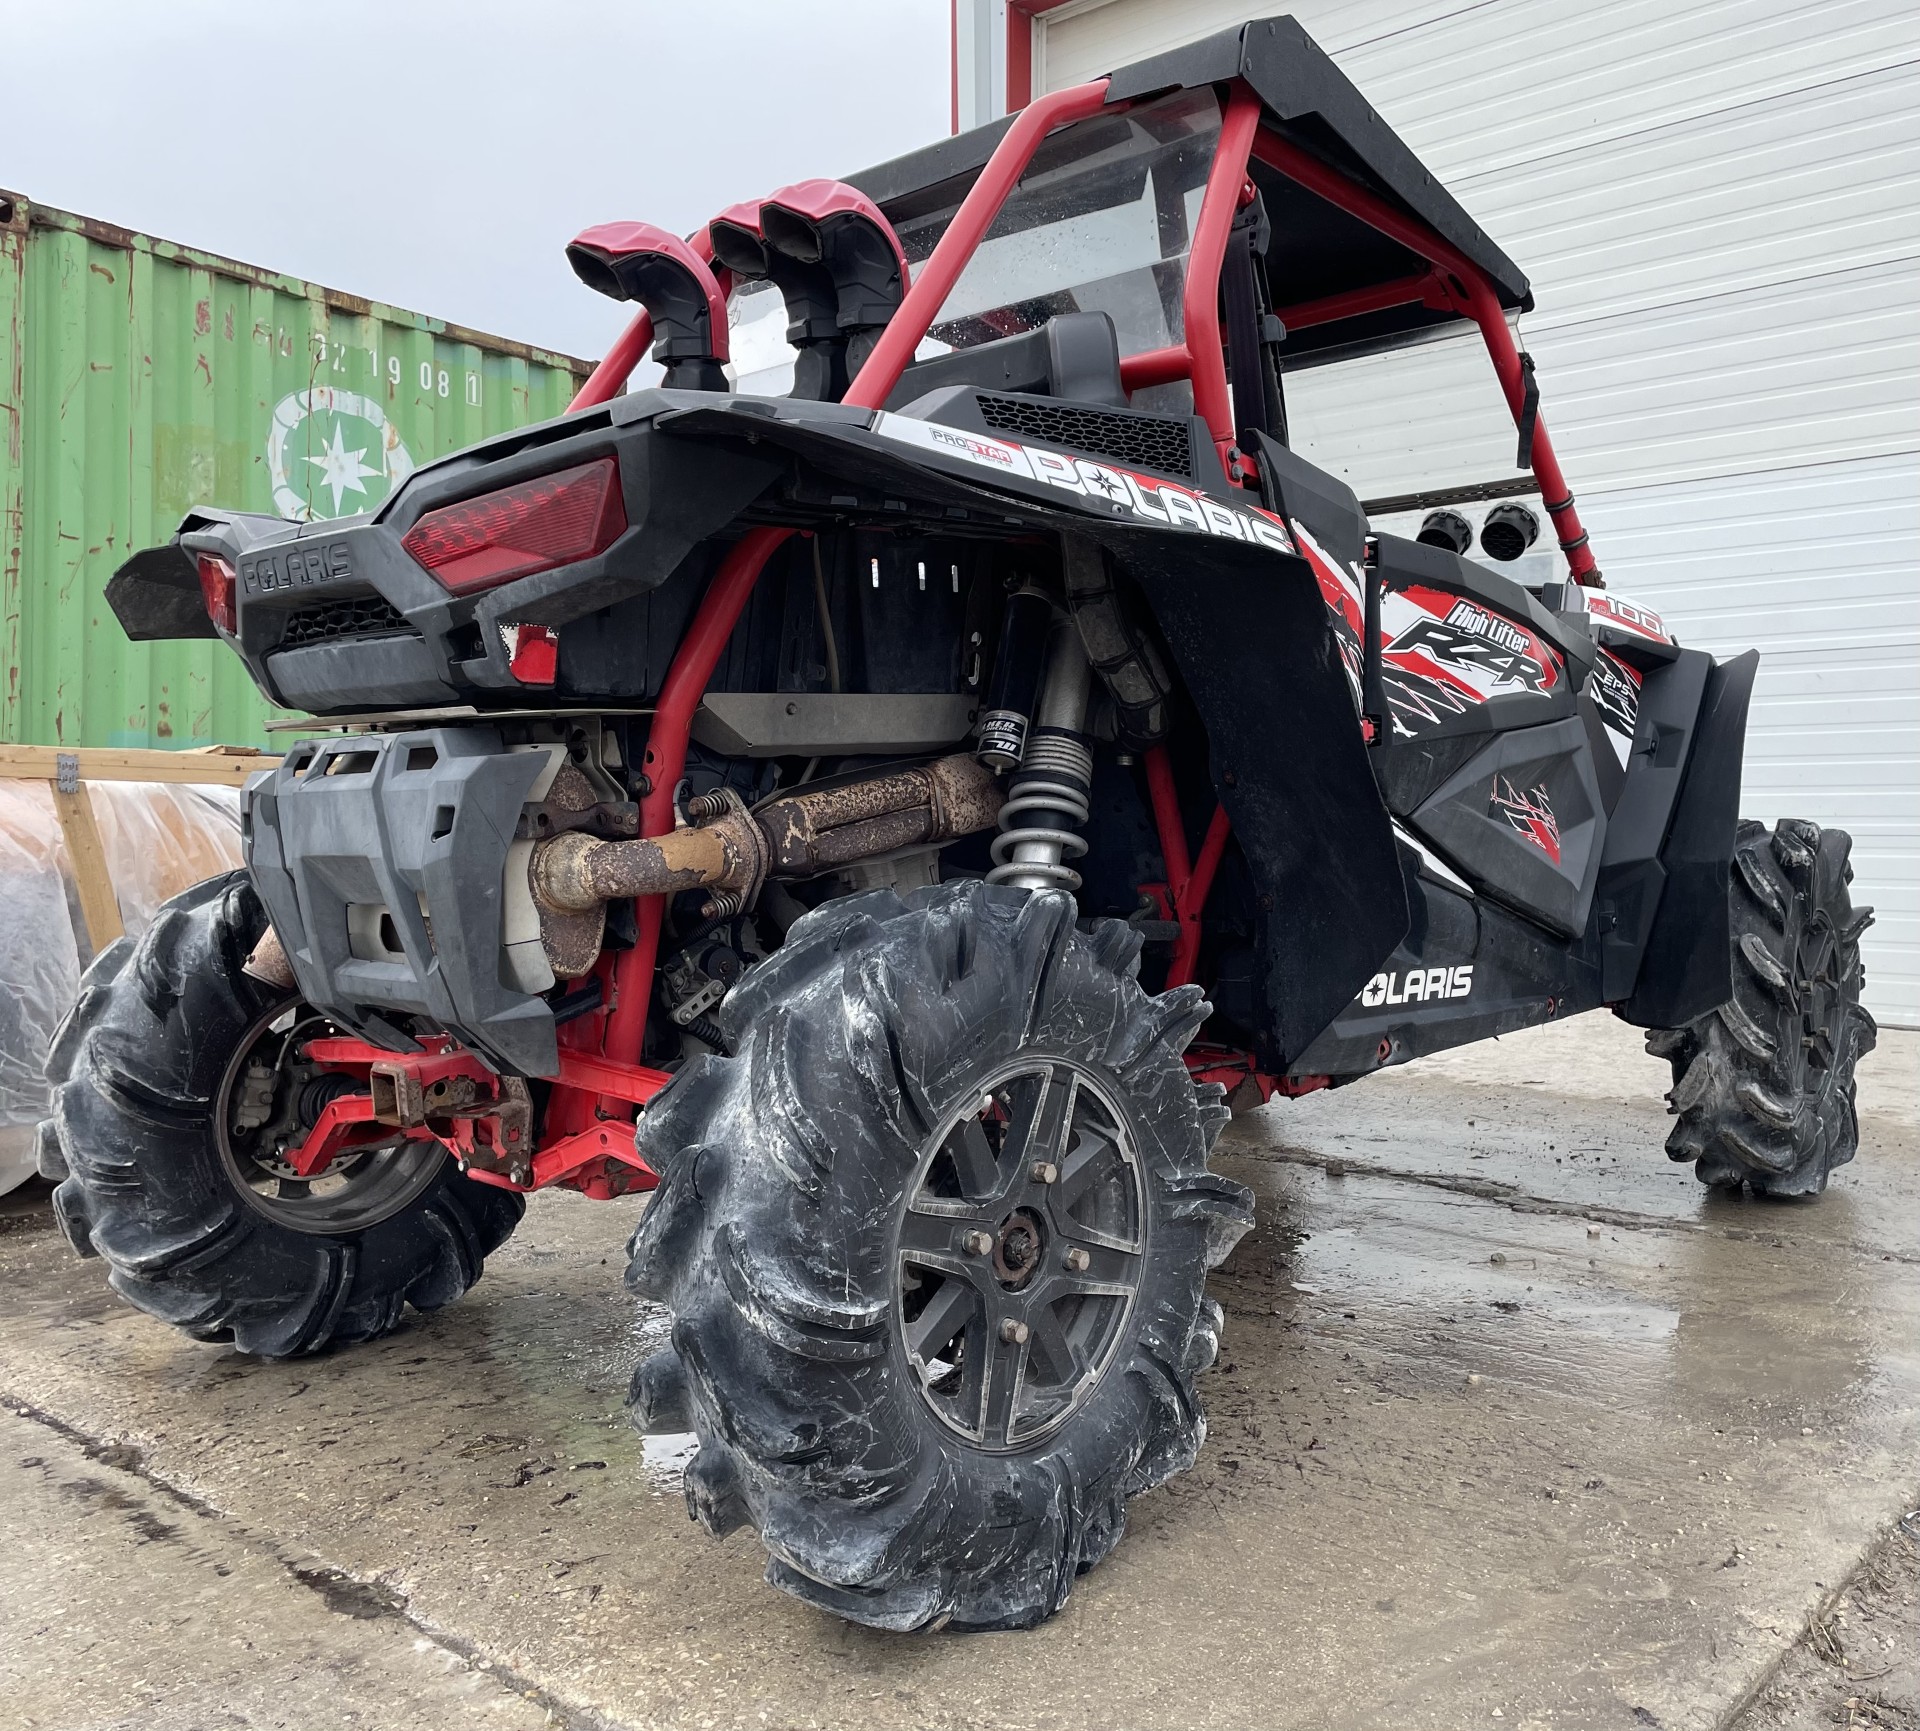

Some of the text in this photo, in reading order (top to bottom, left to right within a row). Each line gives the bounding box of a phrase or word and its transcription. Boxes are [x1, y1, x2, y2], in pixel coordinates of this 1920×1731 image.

[1024, 446, 1294, 554] POLARIS
[241, 542, 353, 595] POLARIS
[1446, 603, 1530, 654] High Lifter
[1382, 617, 1551, 698] RZR
[1603, 673, 1631, 697] EPS
[1355, 965, 1474, 1007] OLARIS
